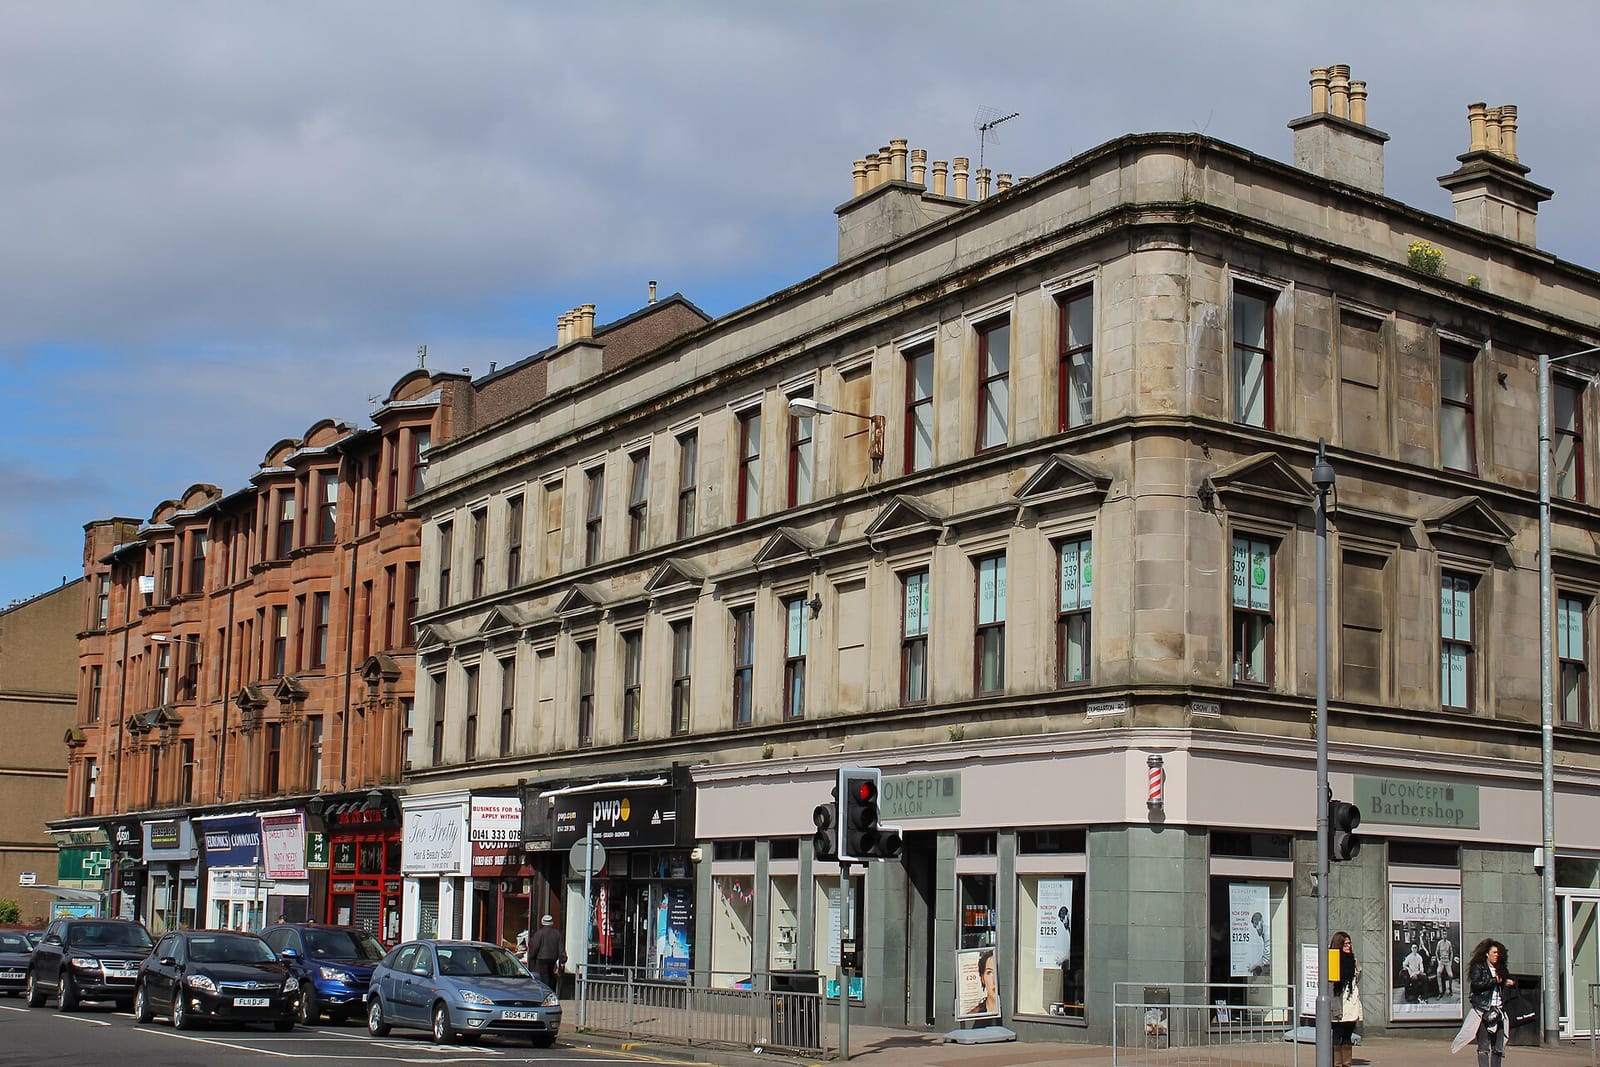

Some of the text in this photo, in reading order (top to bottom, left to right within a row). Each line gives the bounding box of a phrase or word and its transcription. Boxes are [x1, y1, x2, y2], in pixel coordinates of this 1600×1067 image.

[1064, 552, 1078, 563] 0141
[1064, 565, 1077, 577] 339
[1064, 579, 1077, 591] 1961
[908, 595, 919, 606] 339
[908, 608, 919, 618] 1961
[1087, 703, 1124, 714] DUMBARTON RD
[1192, 704, 1219, 713] CROW RD
[593, 800, 620, 828] pwp
[893, 801, 922, 815] SALON
[1372, 796, 1463, 825] Barbershop
[429, 811, 459, 850] Pretty
[472, 830, 489, 840] 0141
[492, 830, 506, 840] 333
[207, 835, 229, 848] EURONICS
[413, 850, 422, 860] Hair
[427, 849, 440, 861] Beauty
[441, 848, 452, 859] Salon
[1402, 903, 1450, 916] Barbershop
[1040, 926, 1058, 936] £12.95
[1232, 933, 1250, 942] £12.95
